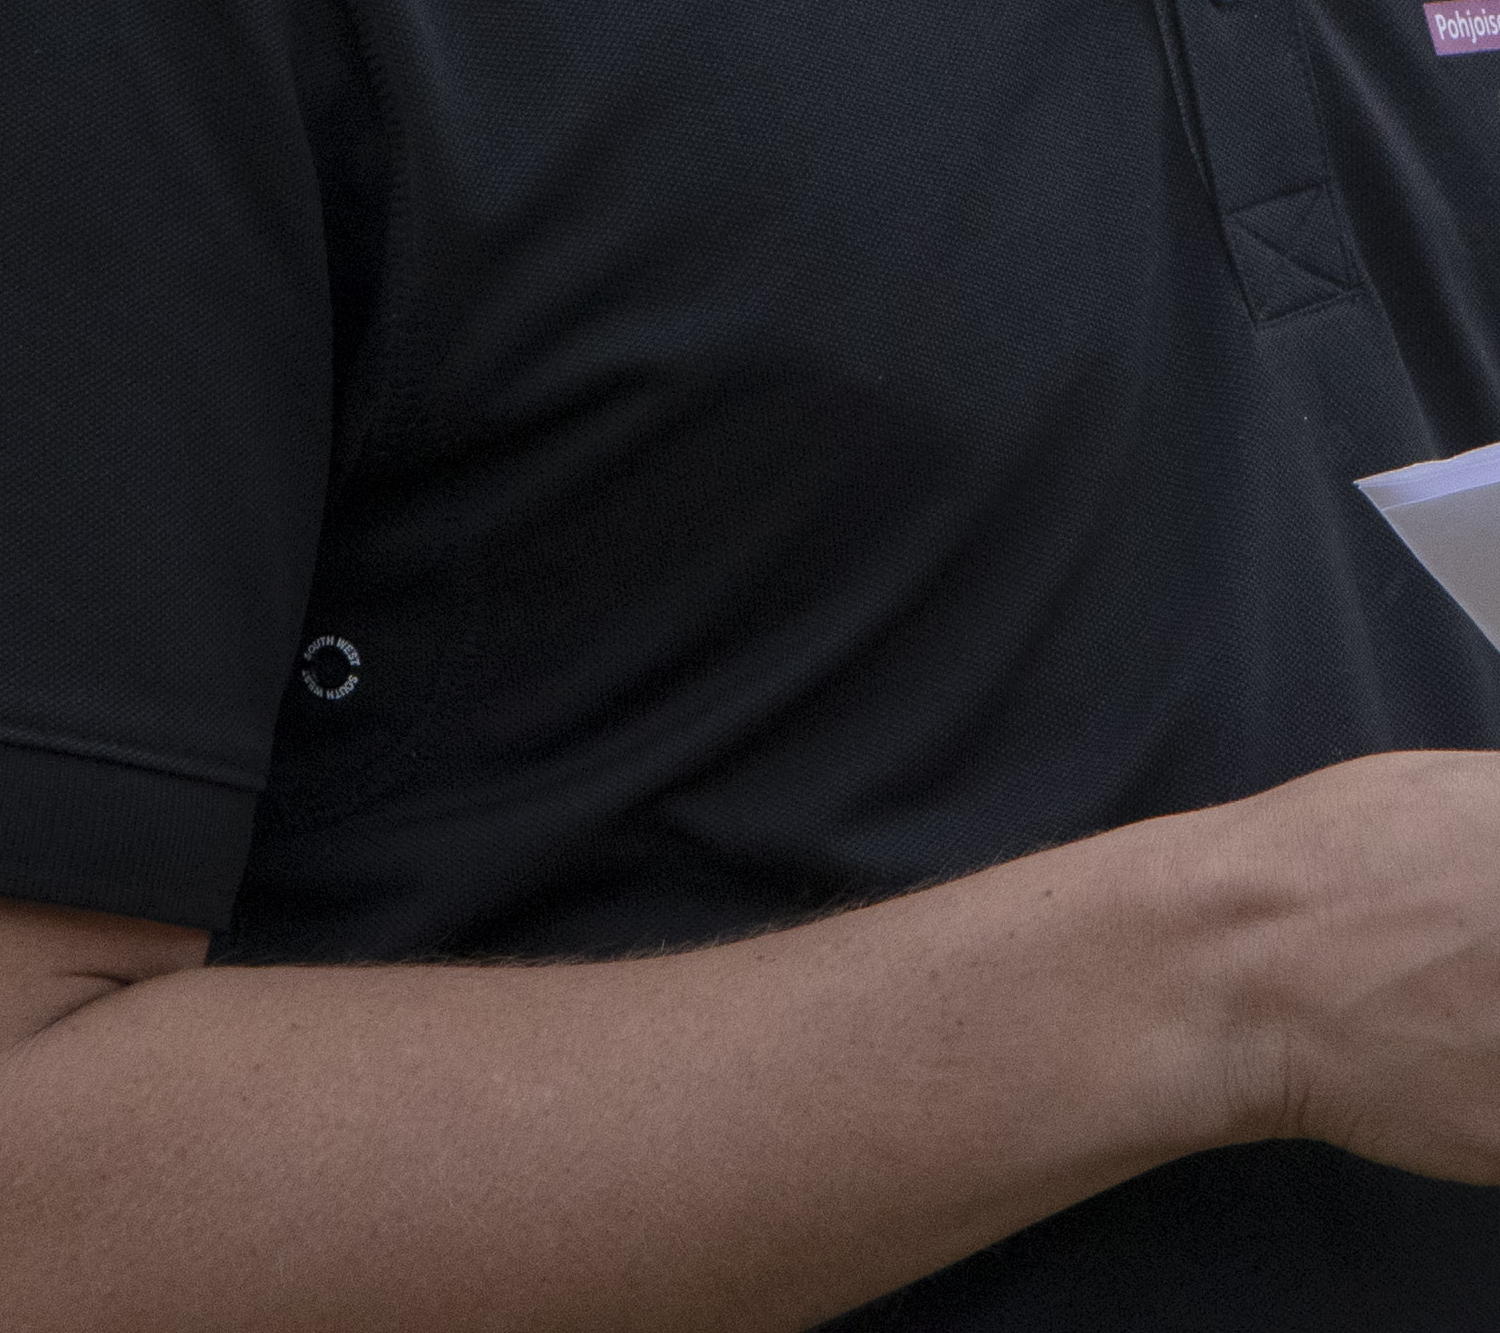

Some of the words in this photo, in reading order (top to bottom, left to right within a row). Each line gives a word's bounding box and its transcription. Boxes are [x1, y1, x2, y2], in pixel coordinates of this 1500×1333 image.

[304, 635, 334, 661] SOUTH
[336, 637, 360, 666] WEST
[327, 674, 359, 700] SOUTH
